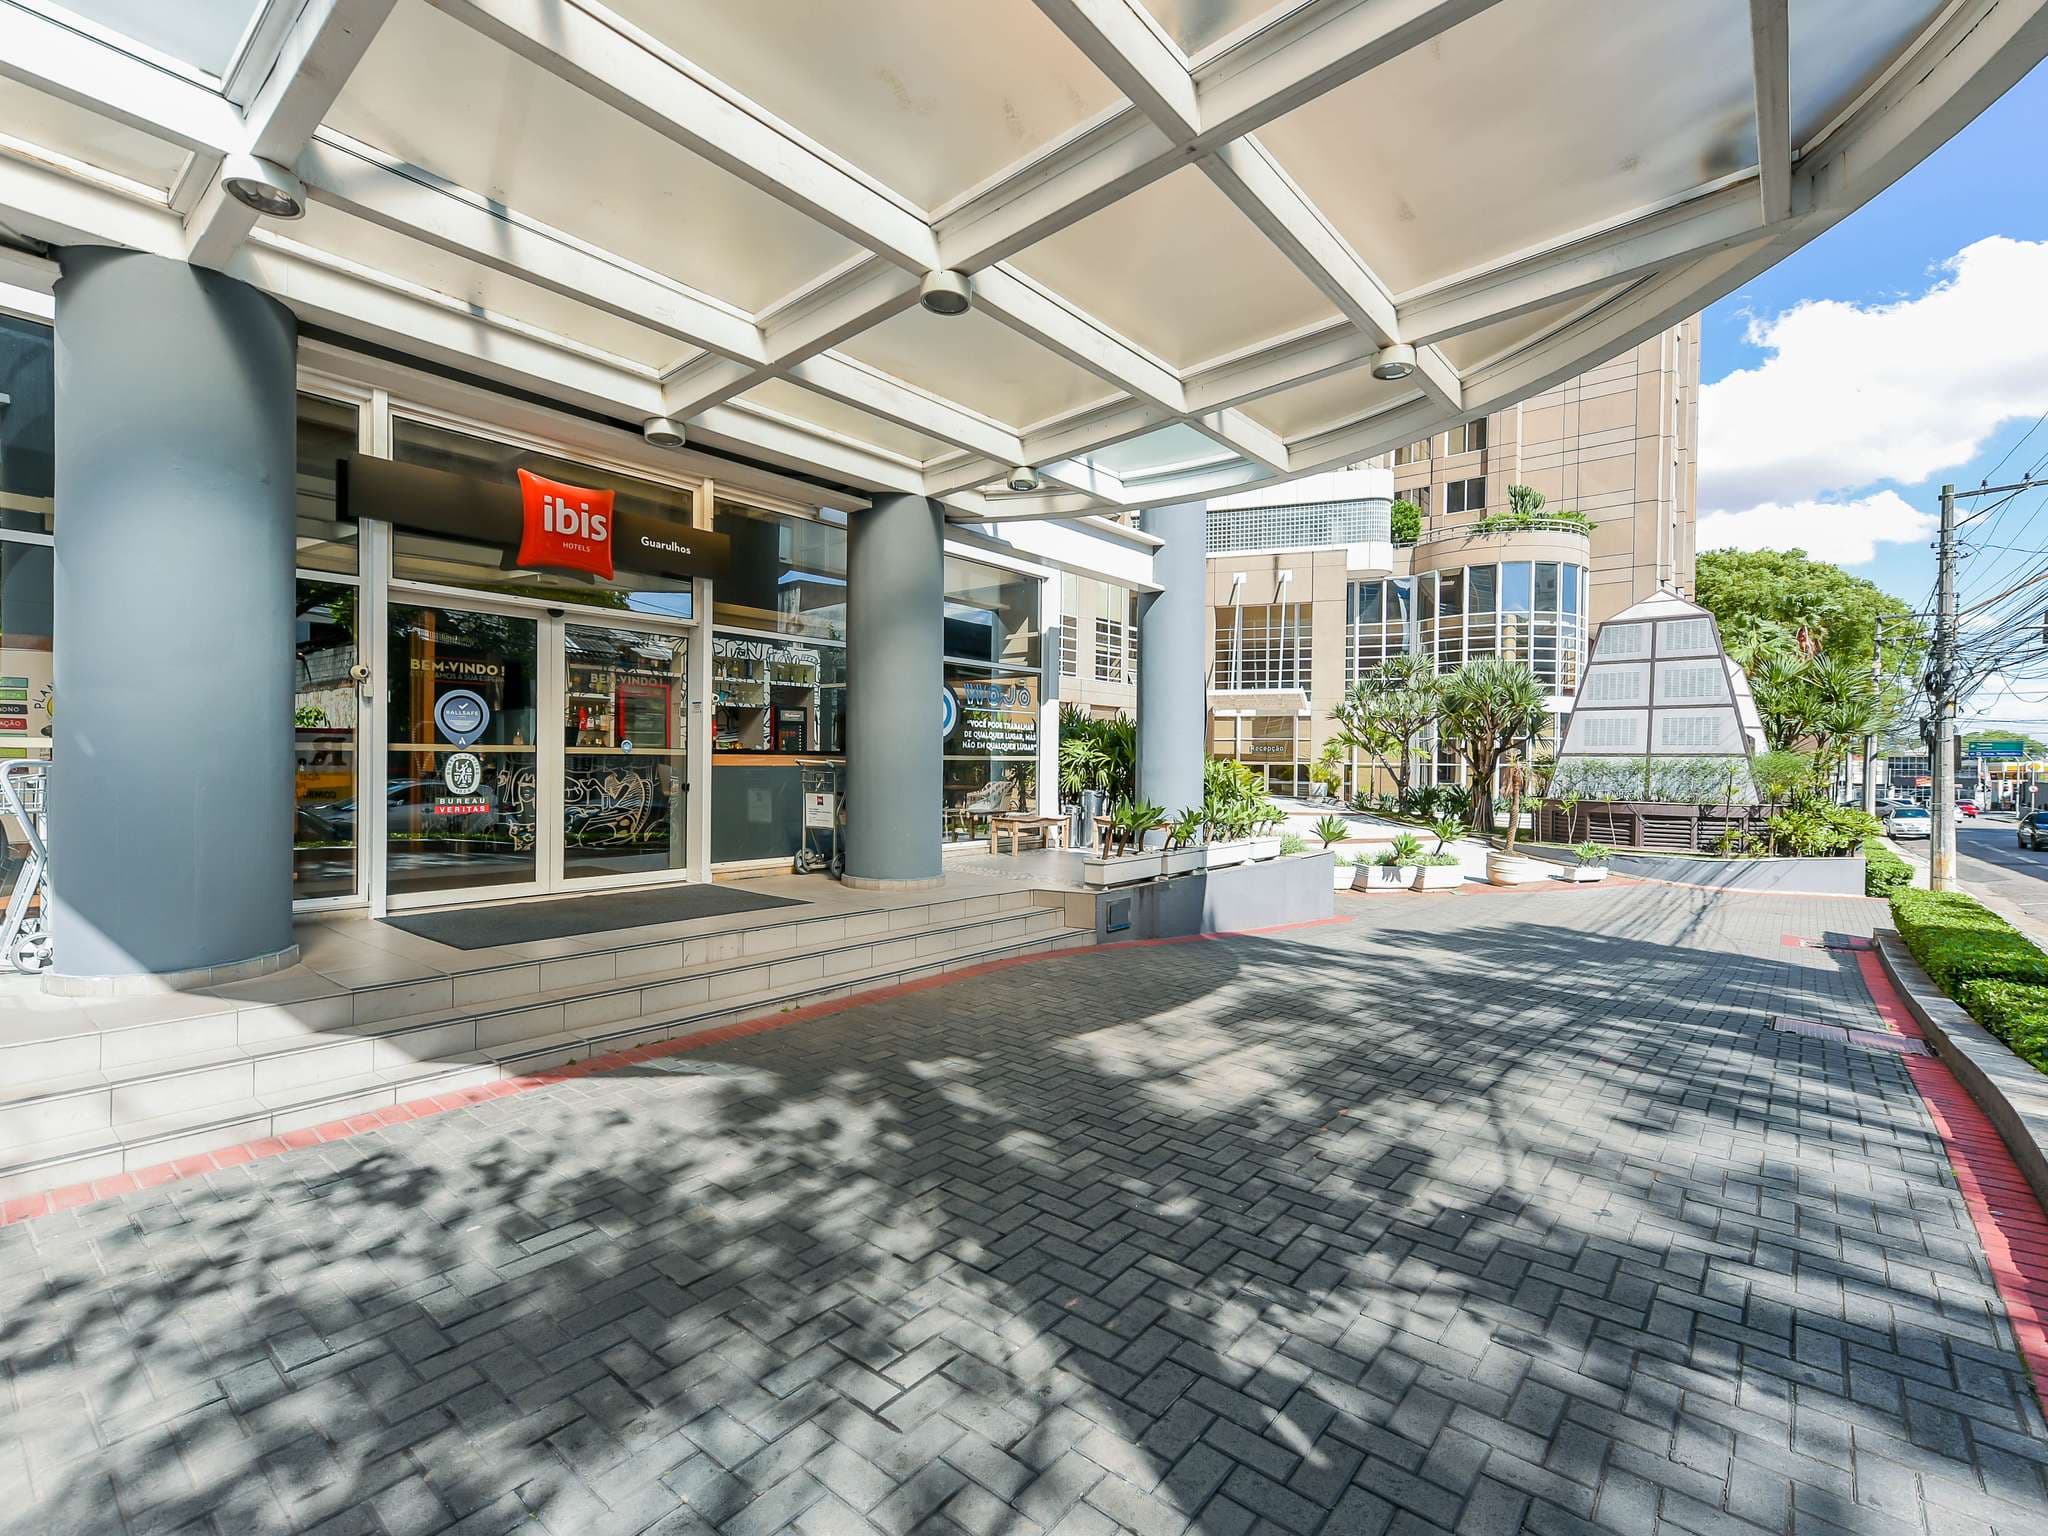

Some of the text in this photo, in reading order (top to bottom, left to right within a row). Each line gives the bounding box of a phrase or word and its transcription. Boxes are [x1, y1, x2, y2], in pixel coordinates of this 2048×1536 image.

[544, 495, 608, 542] ibis
[563, 542, 591, 553] HOTELS
[641, 536, 691, 555] Guarulhos
[410, 658, 499, 676] BEM-VINDO
[964, 730, 973, 738] DE
[973, 731, 1004, 740] QUALQUER
[986, 741, 1016, 751] QUALQUER
[1250, 744, 1285, 753] Recepção
[440, 805, 485, 813] VERITAS
